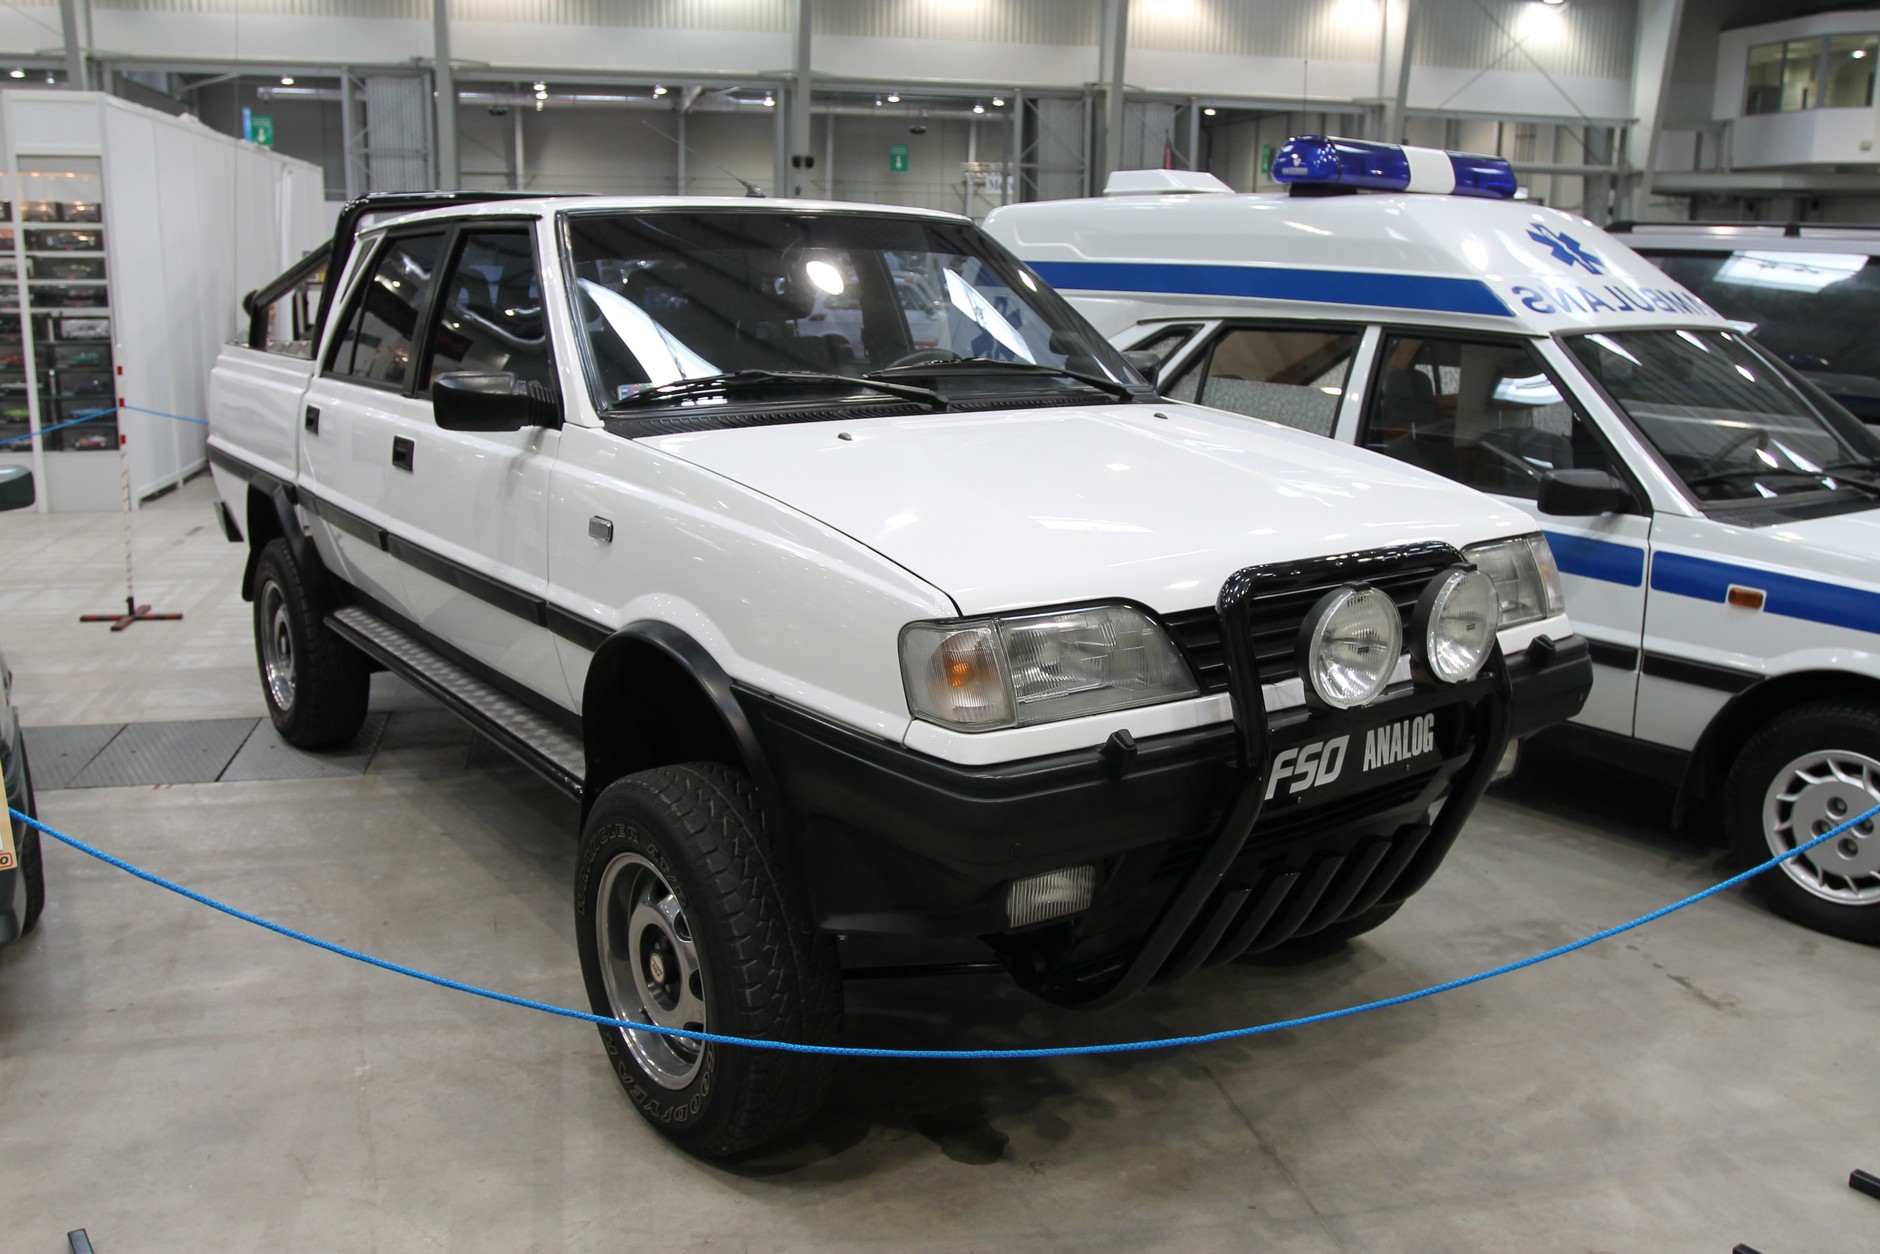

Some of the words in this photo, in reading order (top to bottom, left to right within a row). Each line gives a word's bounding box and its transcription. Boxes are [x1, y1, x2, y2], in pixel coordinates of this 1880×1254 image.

[1264, 734, 1350, 800] FSO
[1363, 713, 1435, 772] ANALOG
[578, 823, 638, 916] WRANGLER
[603, 1031, 715, 1122] GOODYEAR
